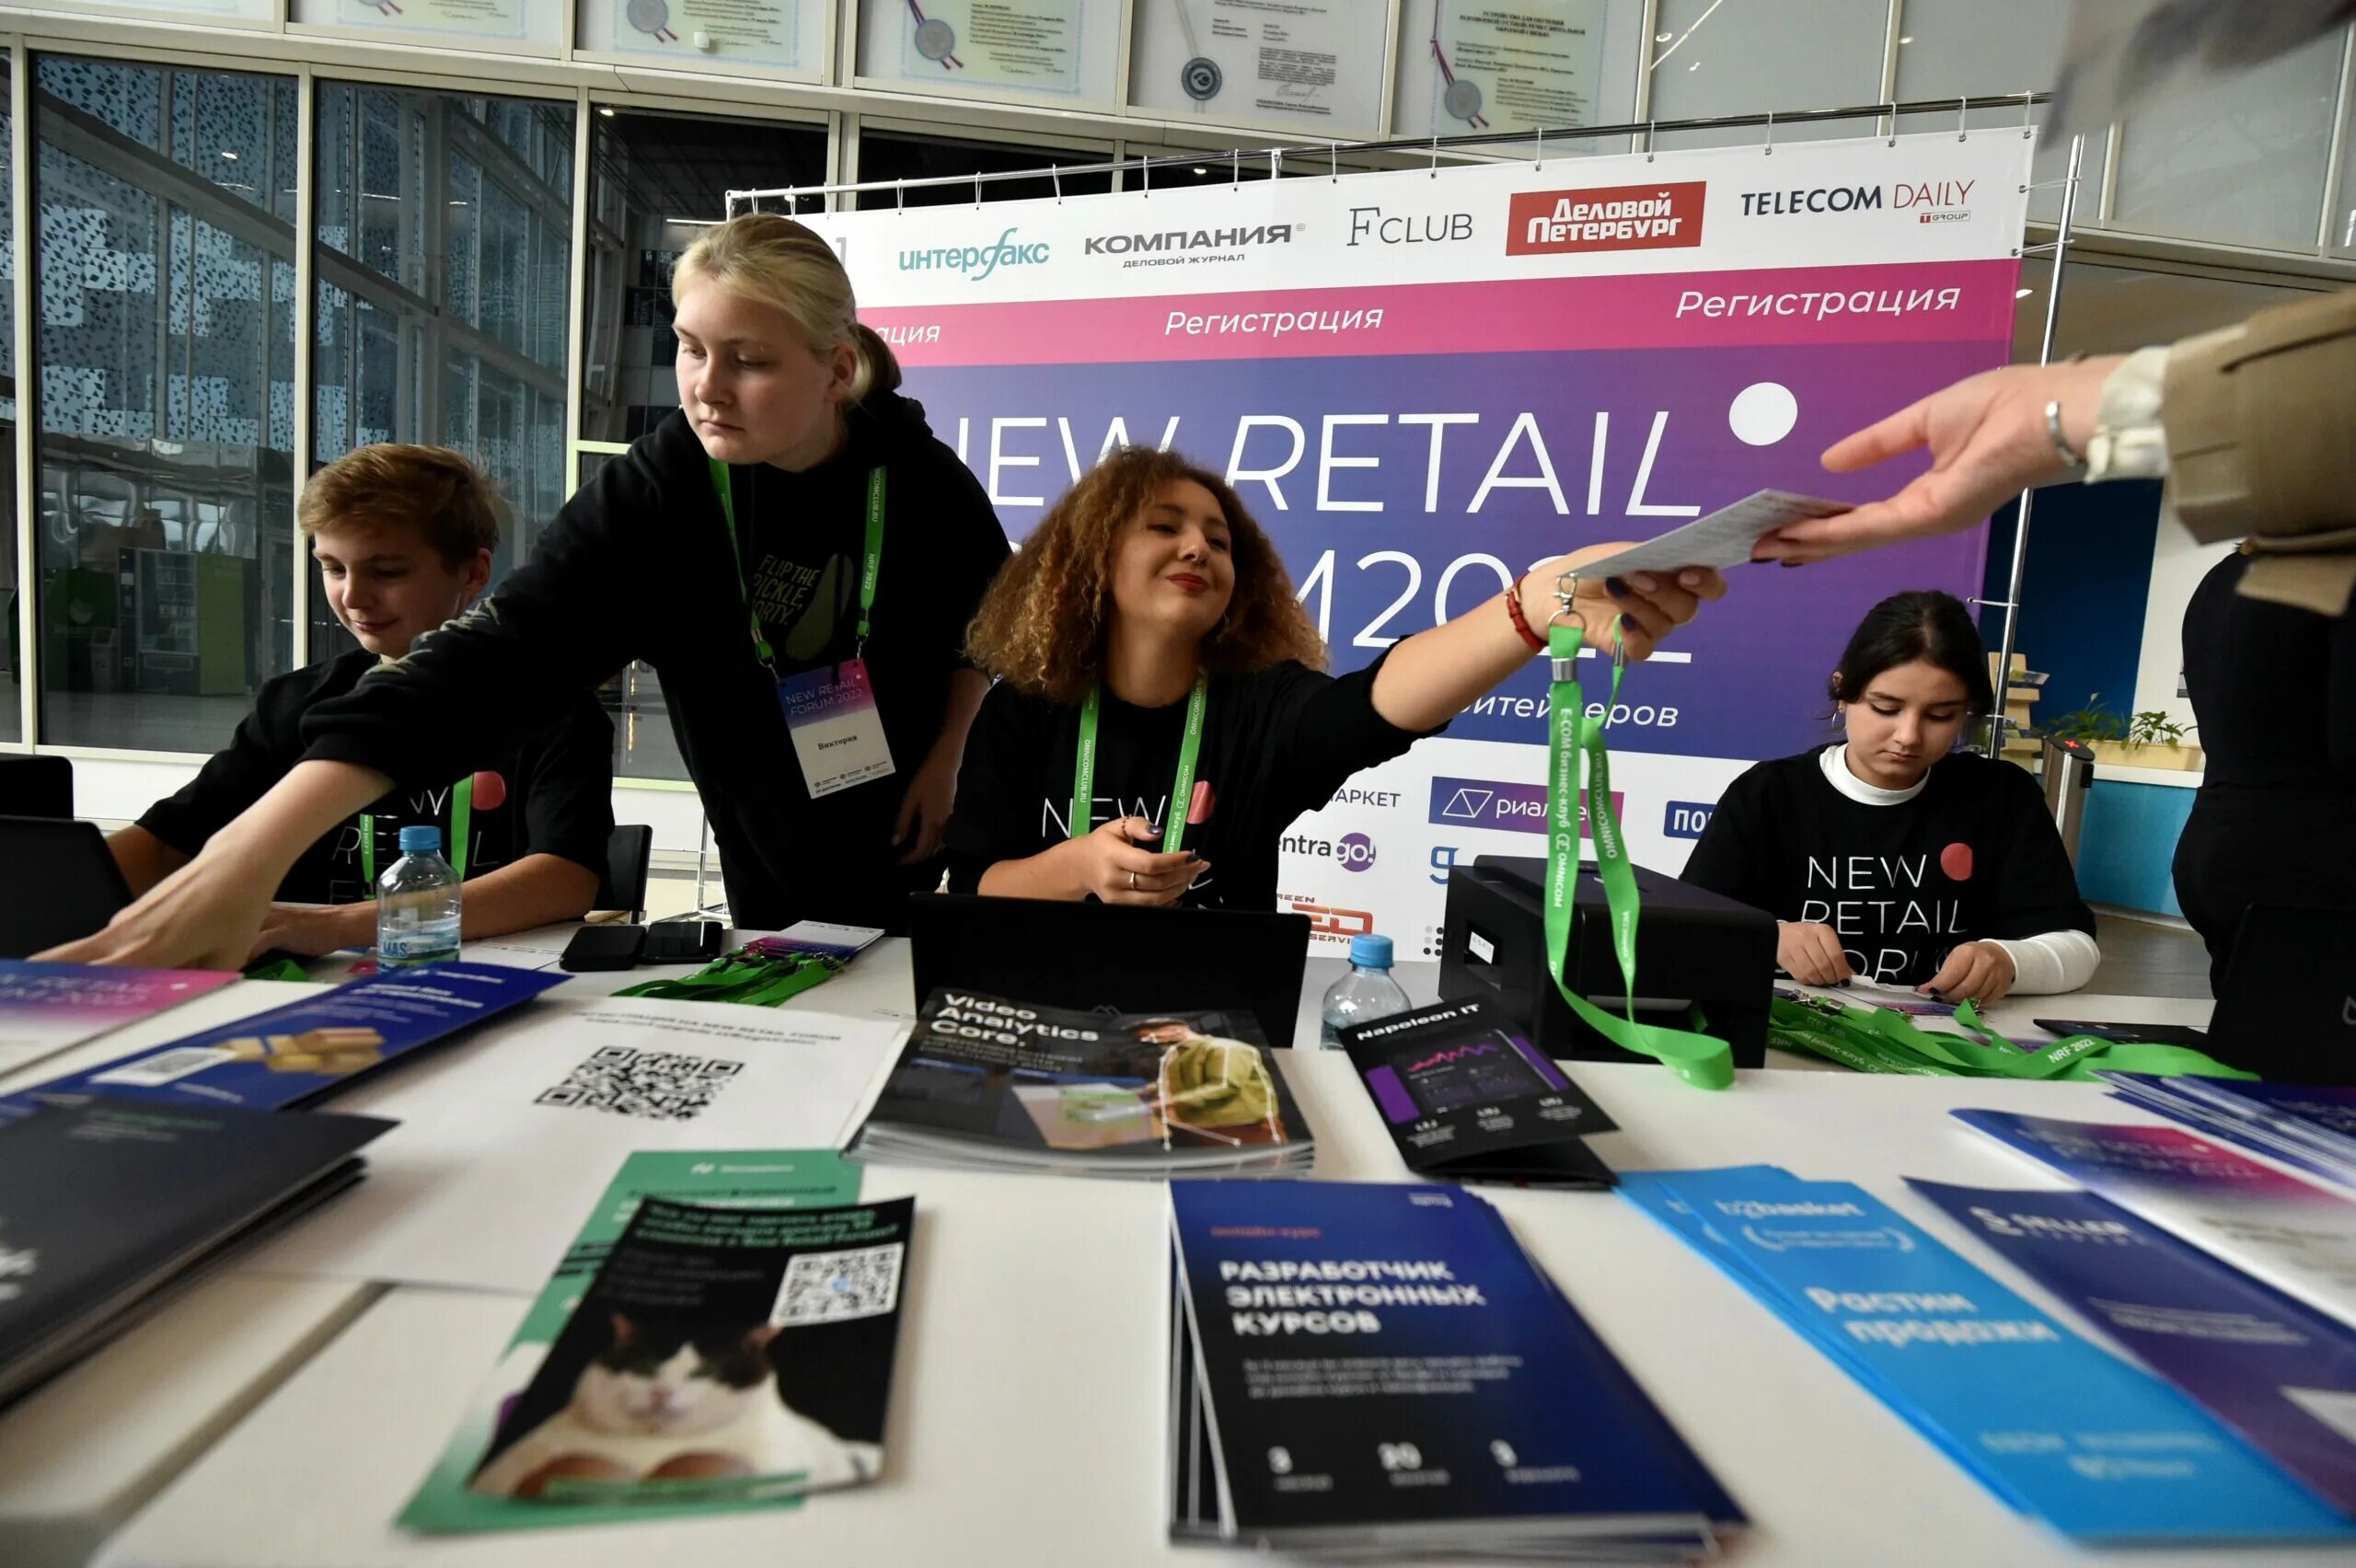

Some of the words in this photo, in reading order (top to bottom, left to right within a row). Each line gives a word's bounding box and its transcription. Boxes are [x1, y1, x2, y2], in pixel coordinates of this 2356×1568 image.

[1741, 185, 1882, 217] TELECOM
[1893, 179, 1975, 209] DAILY
[1085, 224, 1291, 255] КОМПАНИЯ
[1122, 255, 1184, 269] ДЕЛОВОЙ
[1187, 254, 1245, 265] ЖУРНАЛ
[1675, 285, 1961, 320] Регистрация
[1165, 307, 1383, 337] Регистрация
[958, 416, 1180, 506] EW
[1225, 410, 1701, 516] RETAIL
[758, 554, 794, 577] FLIP
[791, 566, 821, 586] THE
[752, 598, 793, 626] ORTY.
[1460, 695, 1679, 729] итейеров
[1559, 708, 1573, 748] E-COM
[817, 735, 858, 750] Виктория
[1080, 739, 1091, 803] OMNICOMCLUB.RU
[1179, 765, 1190, 797] OMNICOM
[1328, 789, 1401, 807] АРКЕТ
[1556, 750, 1572, 828] бизнес-клуб
[1553, 852, 1568, 908] OMNICOM
[1807, 855, 1927, 889] NEW
[1801, 900, 1967, 934] RETAIL
[944, 994, 1037, 1020] Video
[930, 1020, 1026, 1047] Core.
[936, 1007, 1100, 1042] Analytics
[1357, 1009, 1457, 1041] Napoleon
[2049, 1043, 2073, 1065] NRF
[1219, 1260, 1455, 1281] РАЗРАБОТЧИК
[1227, 1286, 1486, 1308] ЭЛЕКТРОННЫХ
[1232, 1310, 1381, 1335] КУРСОВ
